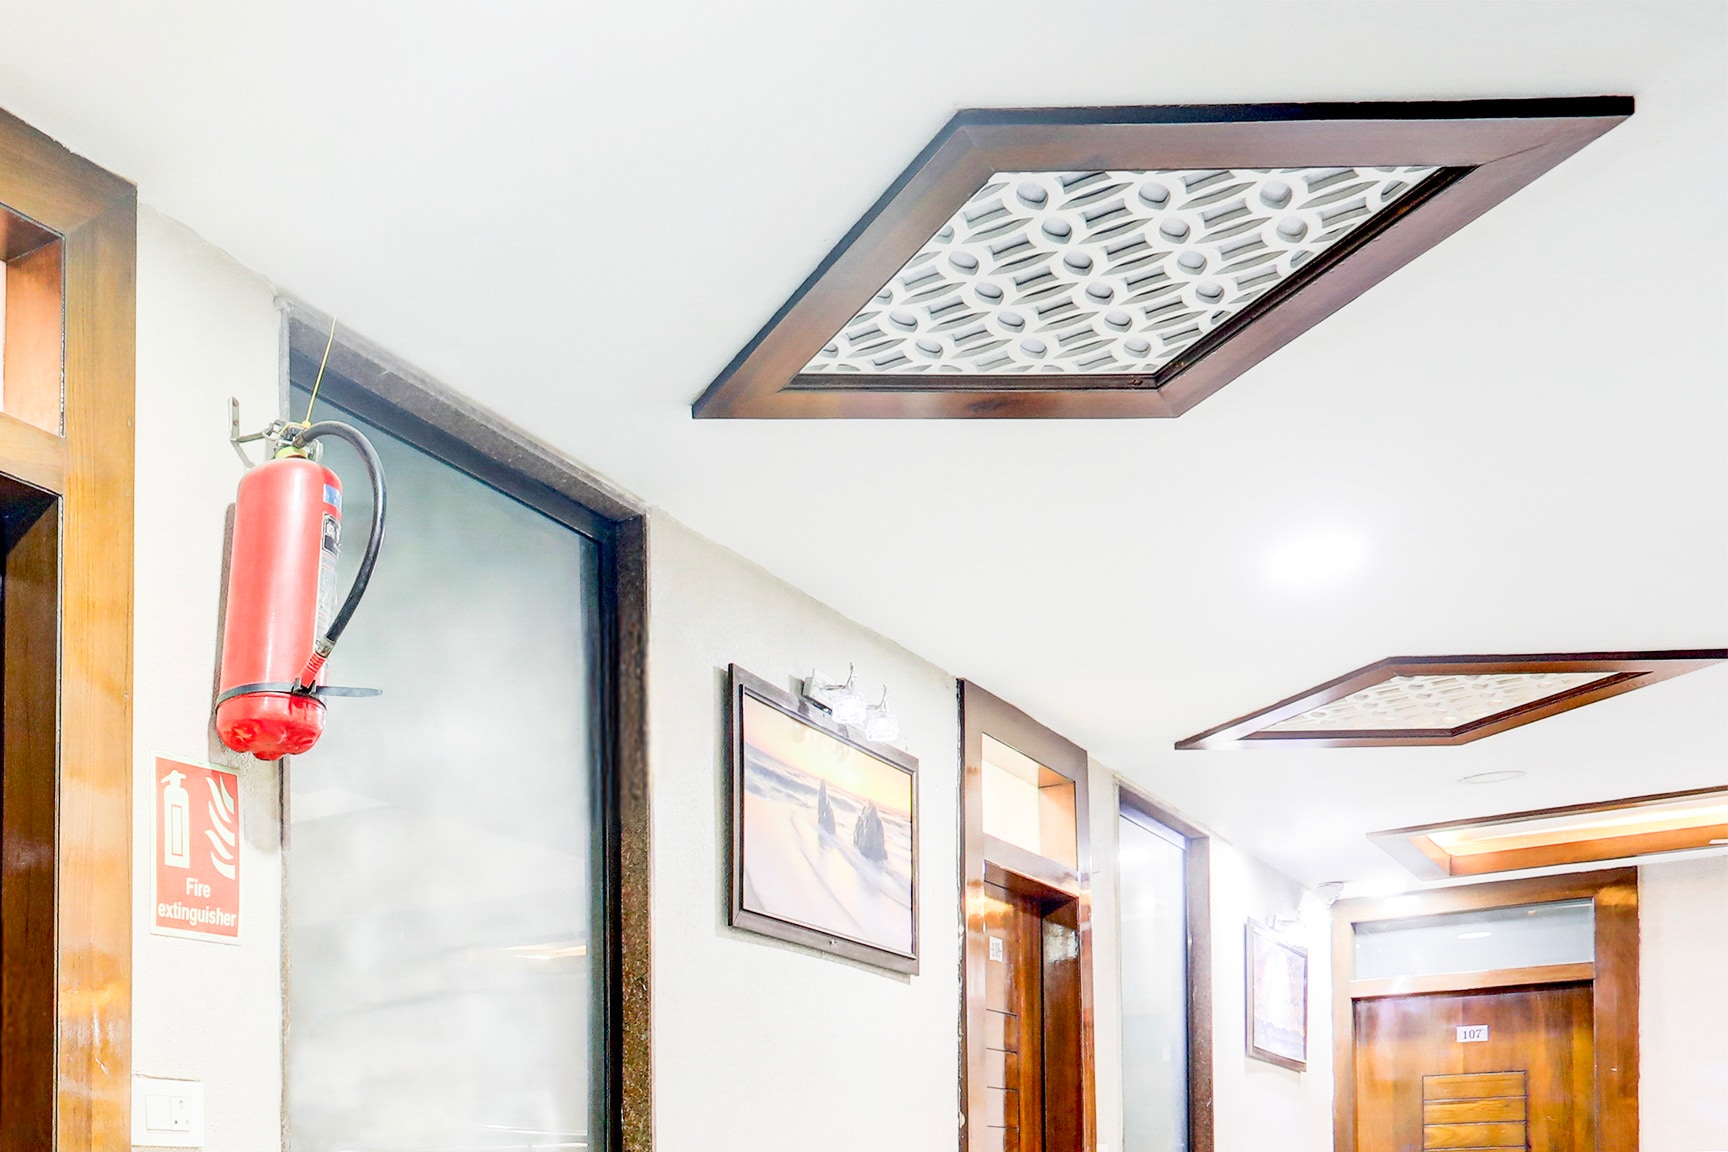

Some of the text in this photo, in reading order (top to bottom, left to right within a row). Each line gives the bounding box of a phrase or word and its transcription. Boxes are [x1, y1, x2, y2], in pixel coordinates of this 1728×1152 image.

[185, 877, 211, 898] Fire
[158, 902, 237, 927] extinguisher
[1463, 1029, 1482, 1040] 107
